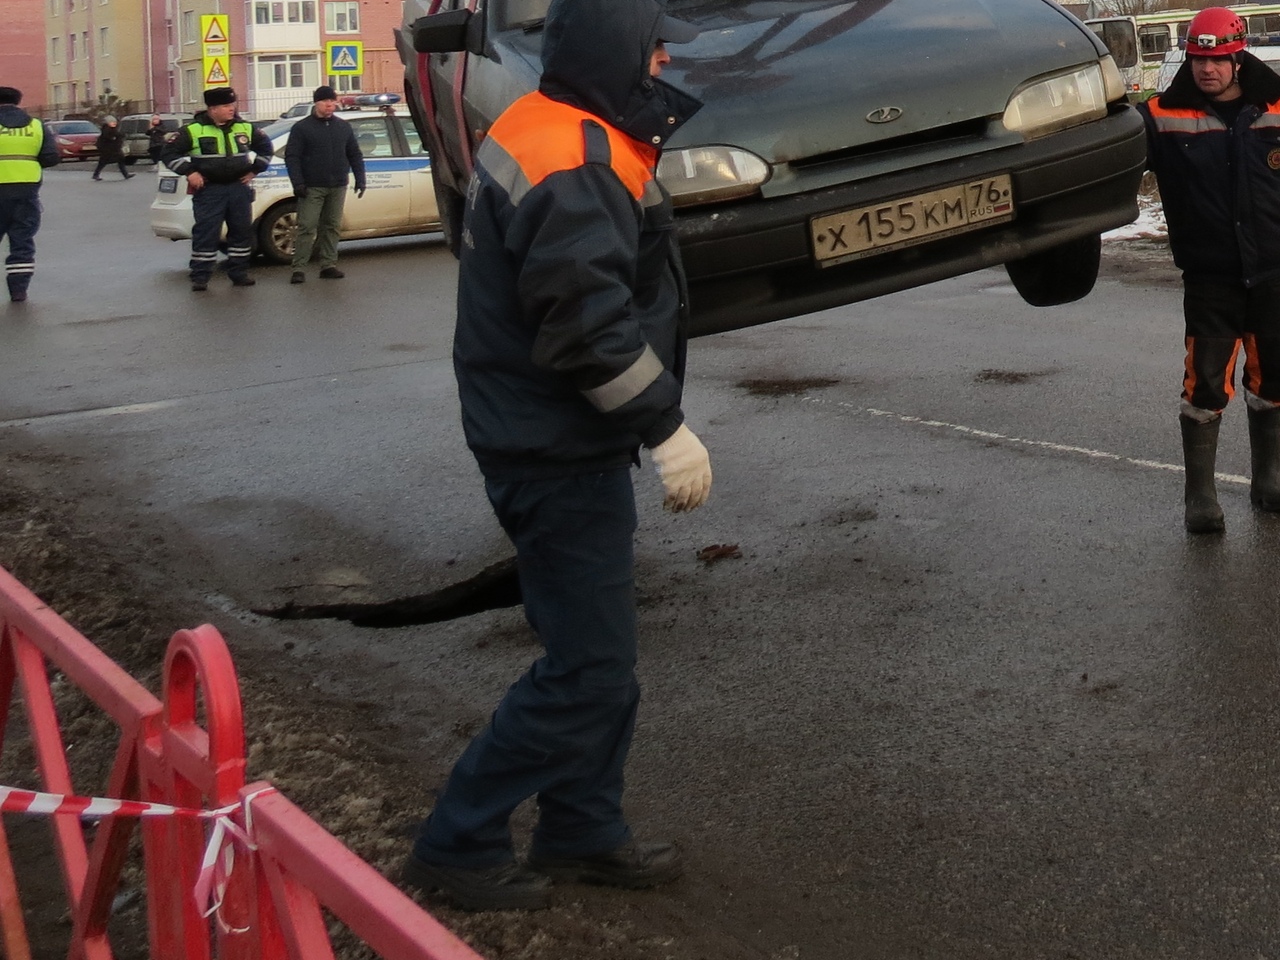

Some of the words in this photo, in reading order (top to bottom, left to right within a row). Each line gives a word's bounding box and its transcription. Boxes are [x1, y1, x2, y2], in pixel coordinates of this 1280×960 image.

[857, 203, 916, 242] 155
[923, 196, 964, 229] КМ
[970, 180, 1001, 206] 76
[969, 205, 993, 218] RUS
